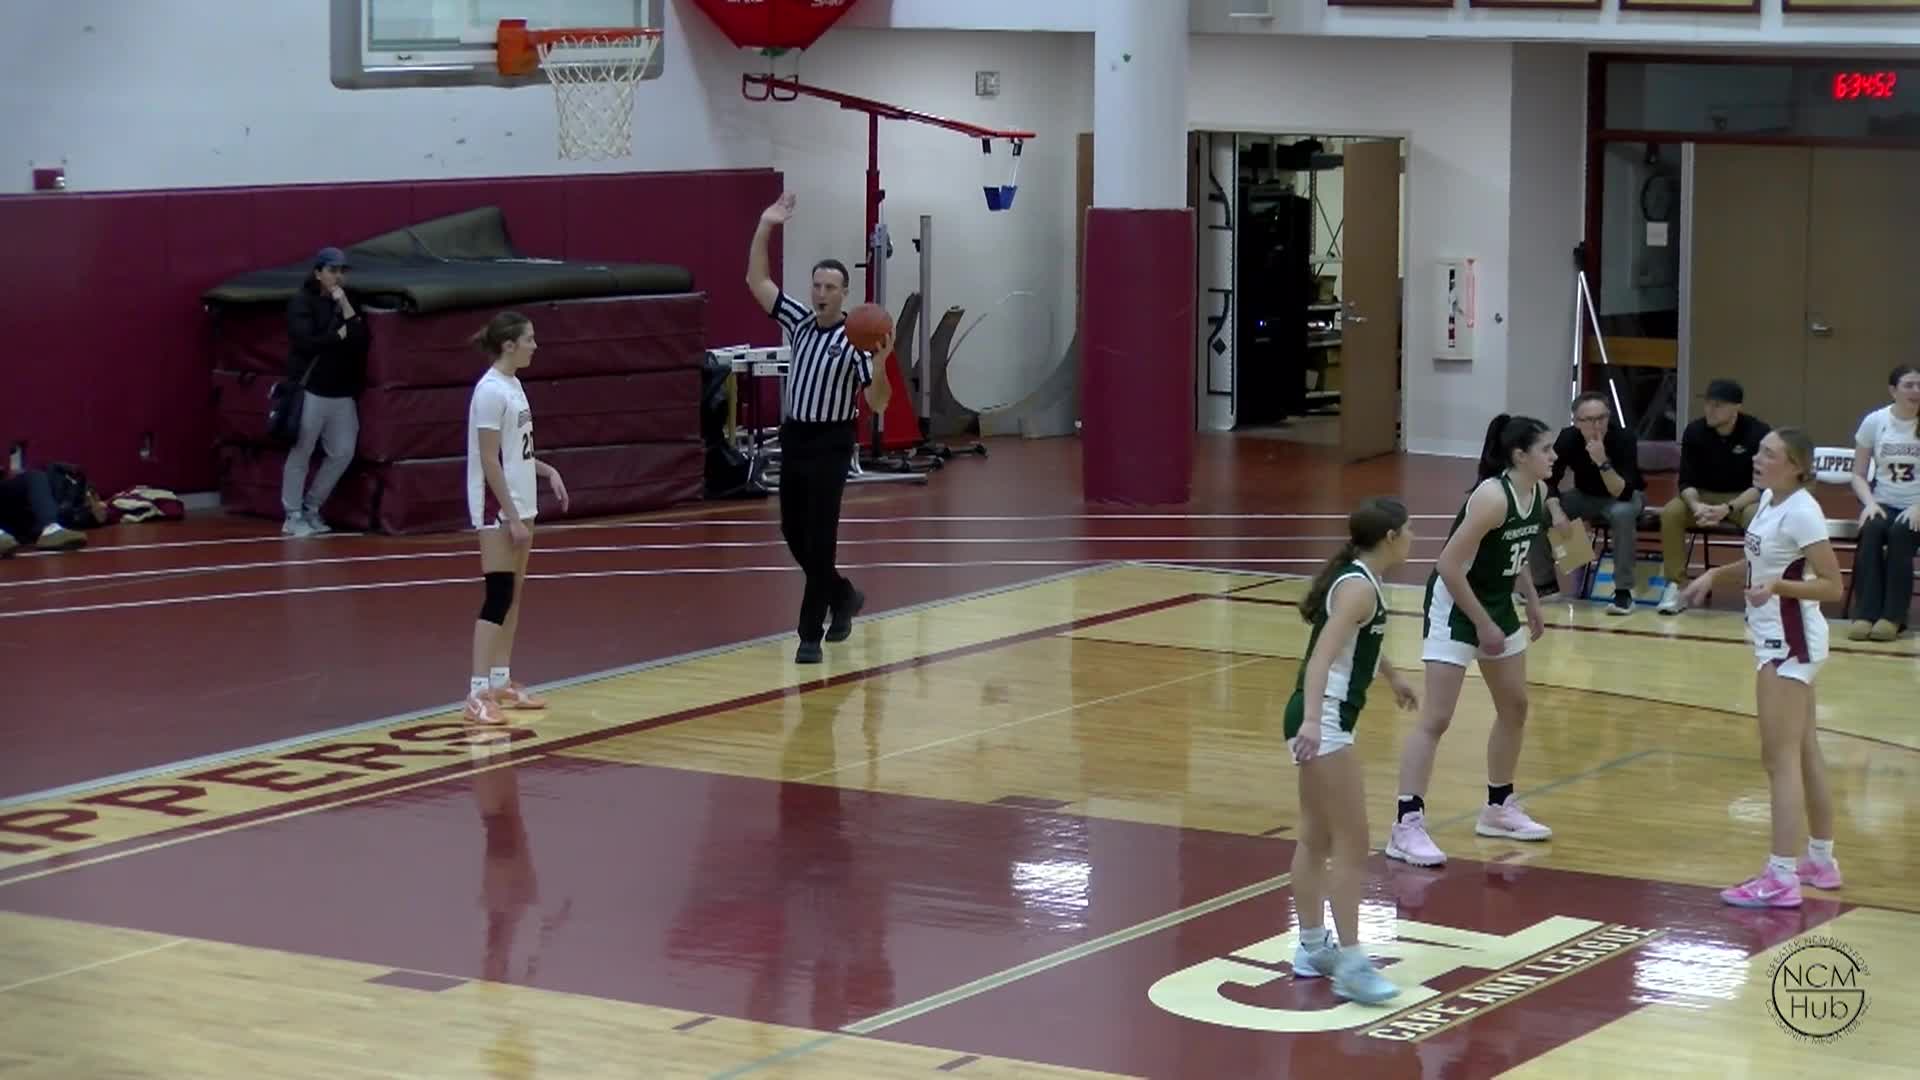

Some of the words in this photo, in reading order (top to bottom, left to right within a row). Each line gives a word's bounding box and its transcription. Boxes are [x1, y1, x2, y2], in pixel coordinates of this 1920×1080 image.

[1888, 463, 1915, 483] 13
[1502, 540, 1530, 576] 32
[1368, 1002, 1478, 1042] CAPE
[1459, 971, 1548, 1005] ANN
[1528, 923, 1658, 974] LEAGUE
